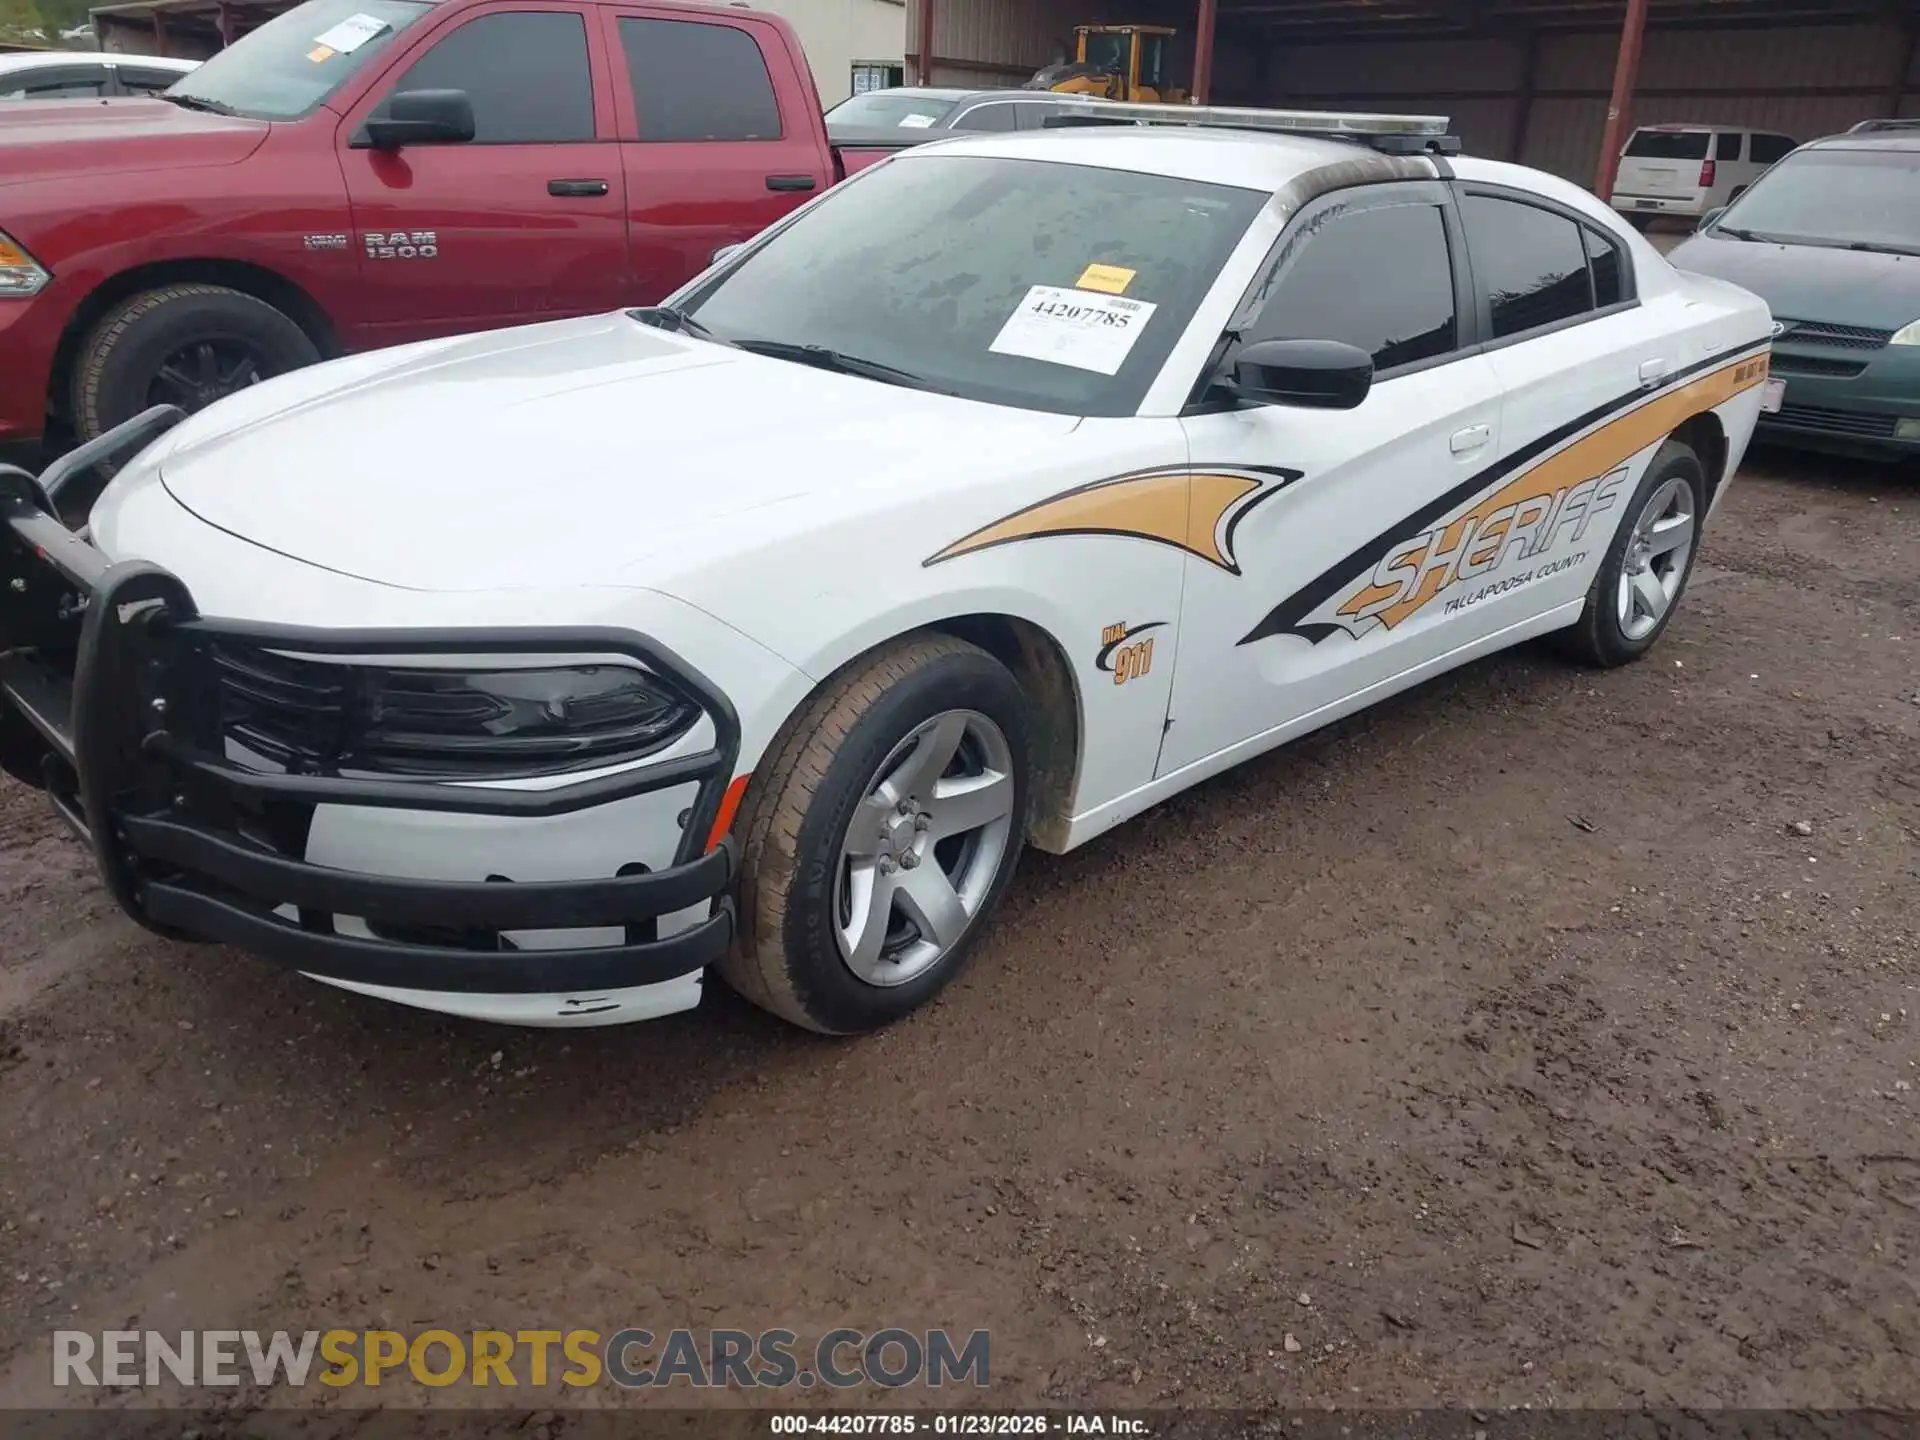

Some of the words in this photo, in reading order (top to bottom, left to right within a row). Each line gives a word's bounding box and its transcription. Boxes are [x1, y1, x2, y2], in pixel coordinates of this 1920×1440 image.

[364, 232, 437, 246] RAM
[366, 245, 437, 258] 1500
[1032, 301, 1132, 328] 44207785
[1354, 467, 1629, 622] SHERIFF
[1443, 569, 1533, 615] TALLAPOOSA
[1536, 550, 1590, 579] COUNTY
[1102, 621, 1126, 646] DIAL
[1113, 637, 1153, 685] 911
